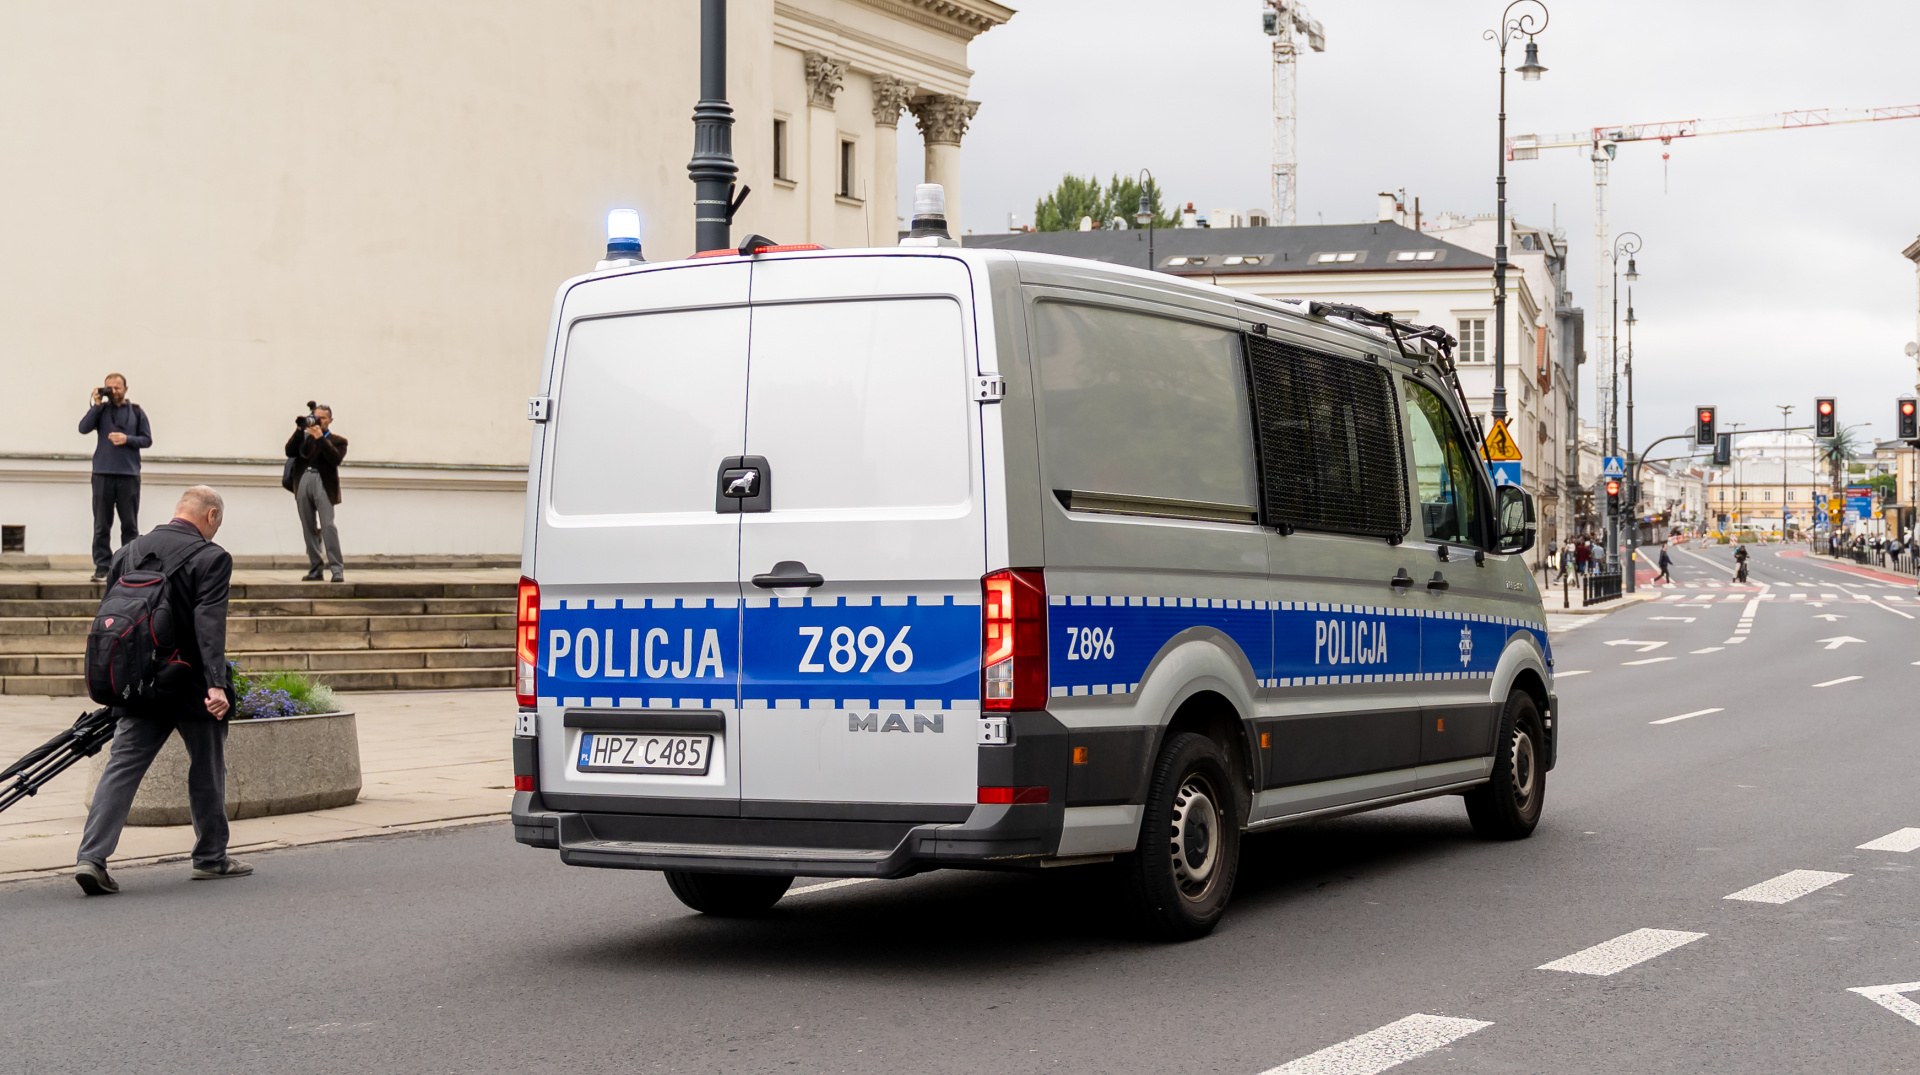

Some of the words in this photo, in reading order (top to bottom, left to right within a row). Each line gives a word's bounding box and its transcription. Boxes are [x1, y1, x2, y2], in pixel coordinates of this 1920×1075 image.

[548, 627, 724, 679] POLICJA
[798, 625, 914, 673] Z896
[1067, 627, 1115, 660] Z896
[1315, 619, 1388, 665] POLICJA
[849, 712, 944, 733] MAN
[581, 753, 589, 761] PL
[594, 737, 638, 764] HPZ
[644, 738, 702, 766] C485
